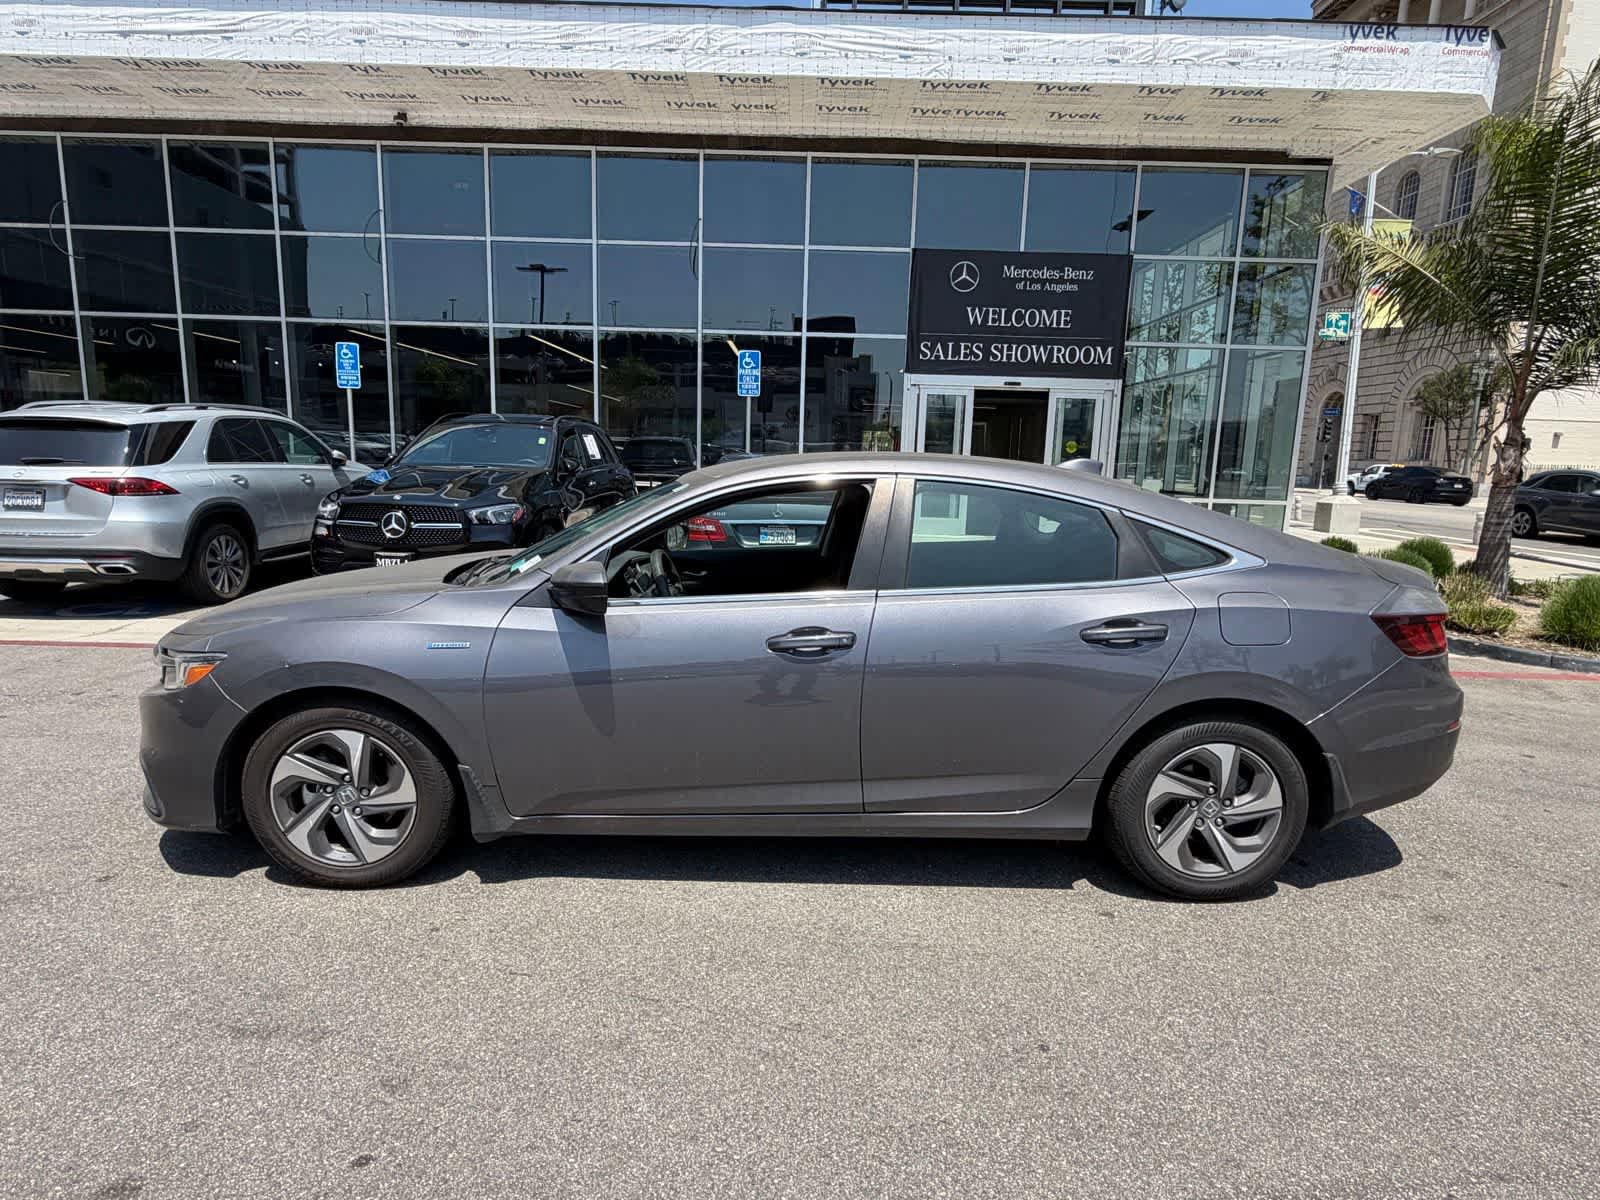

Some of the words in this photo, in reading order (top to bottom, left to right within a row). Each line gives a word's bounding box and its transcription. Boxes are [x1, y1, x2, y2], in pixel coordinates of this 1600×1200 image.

[10, 56, 77, 65] Tyvek
[140, 58, 207, 69] Tyvek
[240, 61, 306, 71] Tyvek
[422, 66, 488, 76] Tyvek
[523, 69, 586, 79] Tyvek
[627, 72, 688, 82] Tyvek
[714, 74, 775, 84] Tyvek
[816, 77, 877, 87] Tyvek
[152, 85, 213, 95] Tyvek
[245, 87, 307, 97] Tyvek
[1033, 83, 1094, 93] Tyvek
[1208, 87, 1270, 97] Tyvek
[458, 94, 514, 104] Tyvek
[815, 103, 872, 113] Tyvek
[1047, 111, 1104, 120] Tyvek
[1002, 265, 1094, 281] Mercedes-Benz
[1015, 281, 1025, 291] of
[1026, 281, 1041, 291] Los
[1043, 282, 1079, 293] Angeles
[967, 306, 1073, 329] WELCOME
[919, 341, 984, 362] SALES
[989, 343, 1114, 366] SHOWROOM
